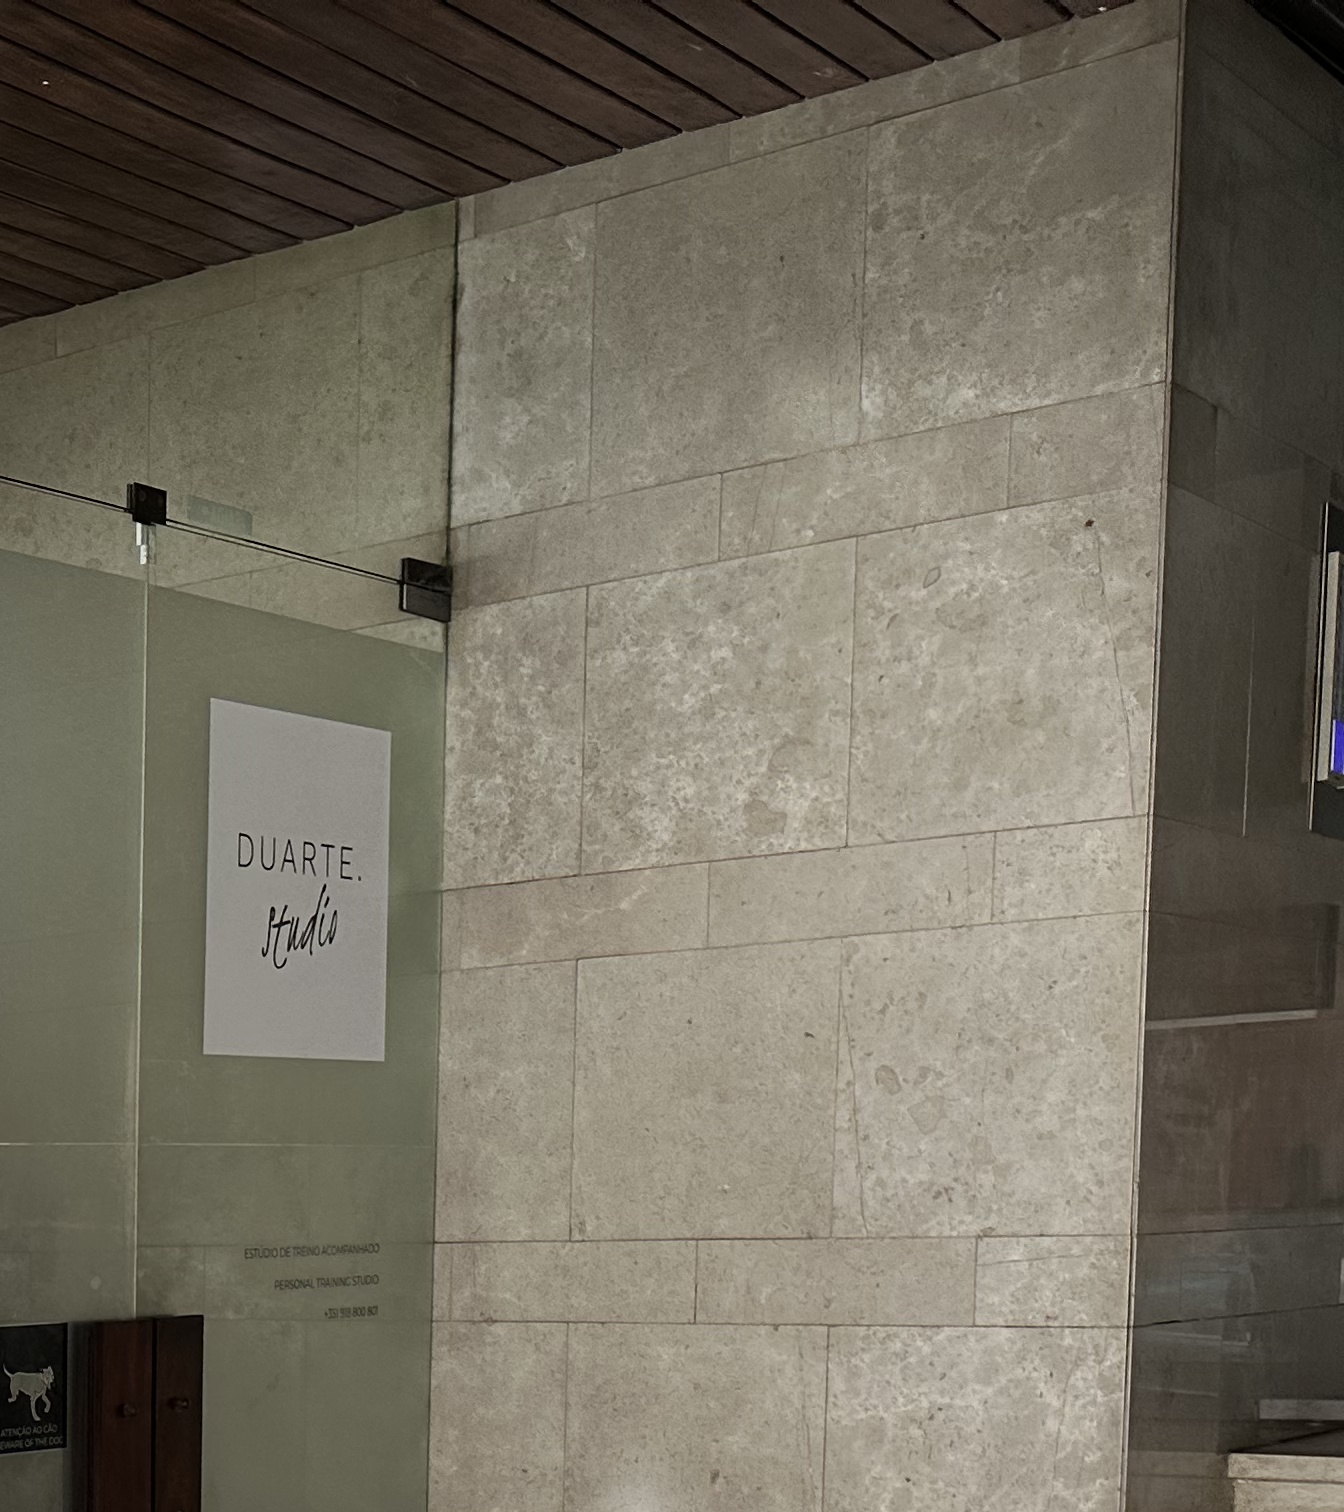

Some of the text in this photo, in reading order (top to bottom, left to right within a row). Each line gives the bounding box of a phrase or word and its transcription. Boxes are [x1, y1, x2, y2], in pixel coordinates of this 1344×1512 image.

[237, 832, 362, 882] DUARTE.
[261, 883, 338, 970] studio
[279, 1246, 291, 1258] DE
[292, 1245, 320, 1257] TREINO
[321, 1242, 380, 1256] ACOMPANHADO
[274, 1274, 380, 1291] PERSONAL TRAINING STUDIO
[0, 1425, 32, 1438] ATENÇÃO
[33, 1426, 43, 1434] AO
[24, 1438, 34, 1447] OF
[34, 1436, 48, 1447] THE
[48, 1435, 64, 1446] DOG
